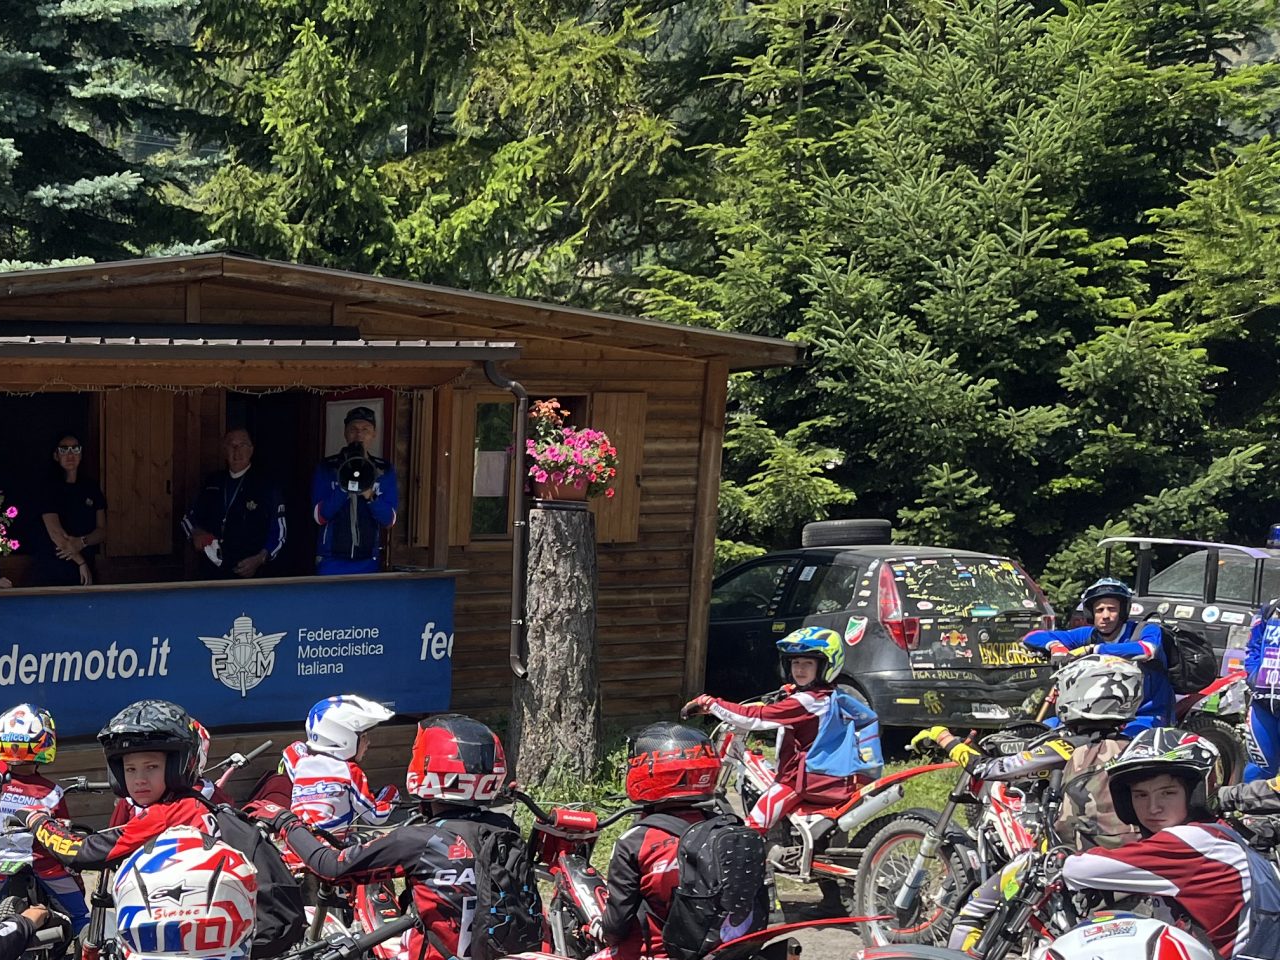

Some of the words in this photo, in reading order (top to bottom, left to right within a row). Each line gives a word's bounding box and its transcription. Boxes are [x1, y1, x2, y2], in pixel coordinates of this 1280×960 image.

[298, 625, 380, 642] Federazione
[298, 642, 385, 660] Motociclistica
[297, 661, 344, 677] Italiana
